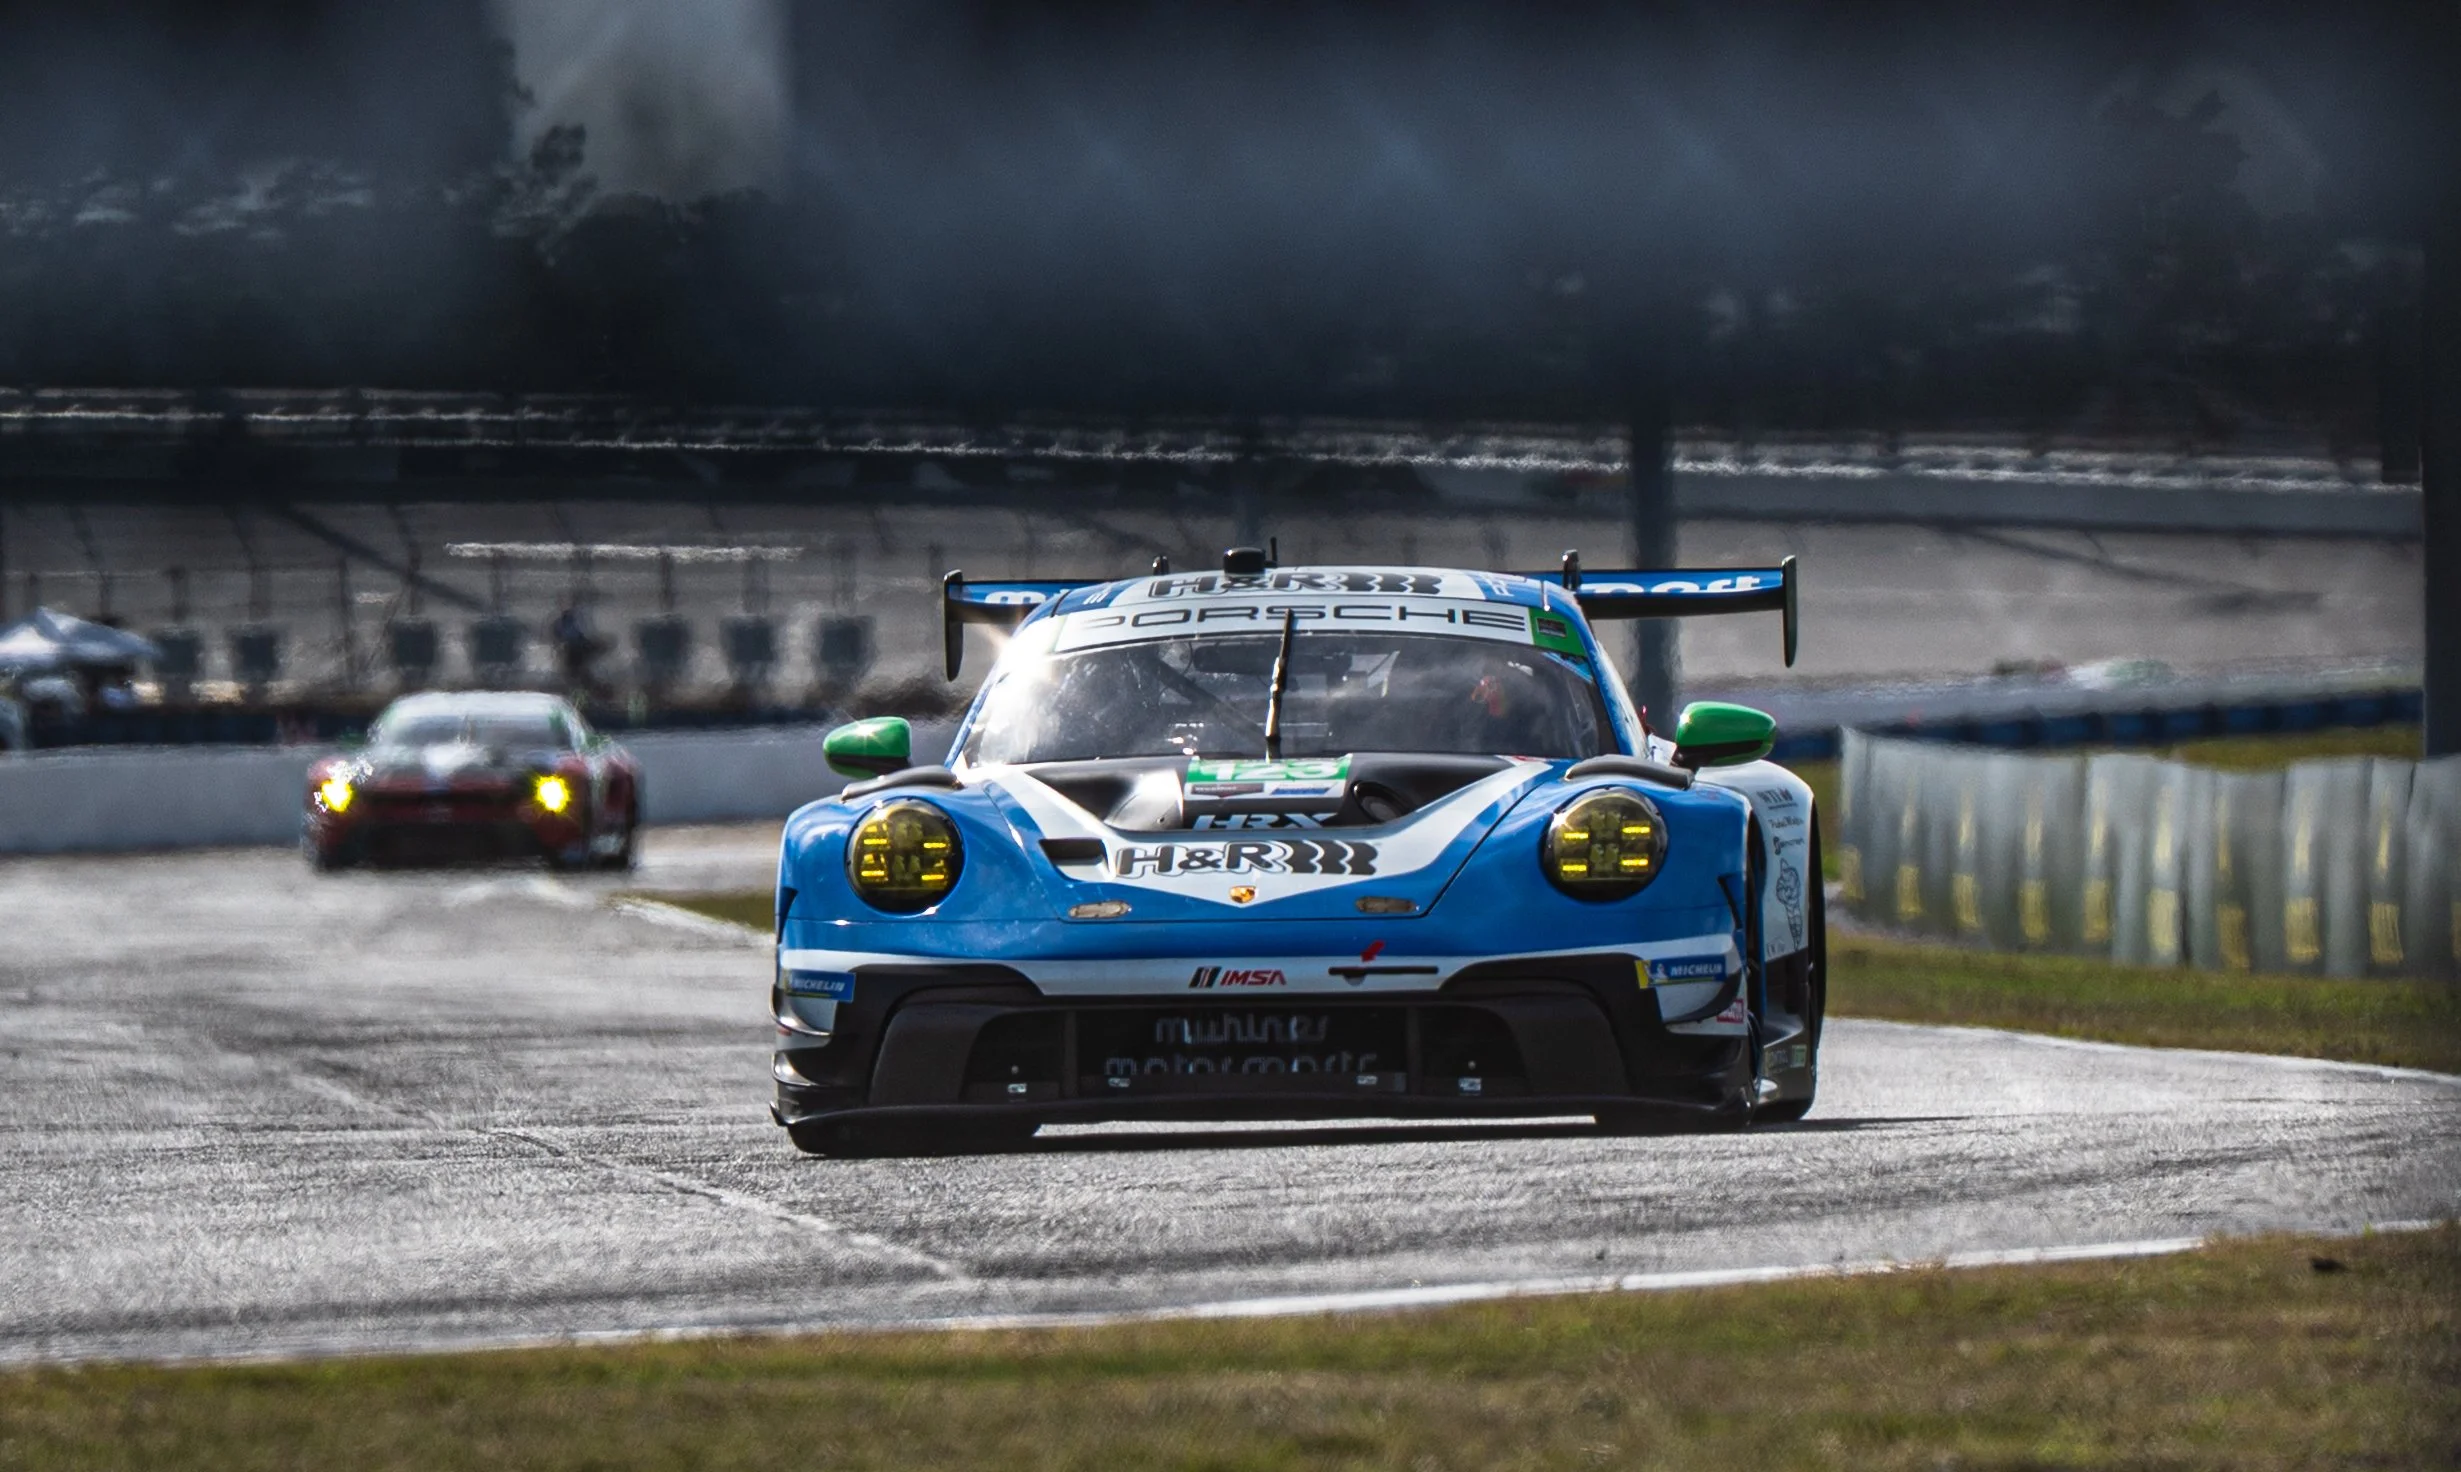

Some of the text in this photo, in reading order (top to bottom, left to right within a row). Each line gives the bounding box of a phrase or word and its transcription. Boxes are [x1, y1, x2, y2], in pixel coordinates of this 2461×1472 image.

[1199, 760, 1341, 781] 123
[1116, 841, 1288, 880] H&R
[1220, 968, 1287, 986] IMSA
[1671, 963, 1723, 976] MICHELIN
